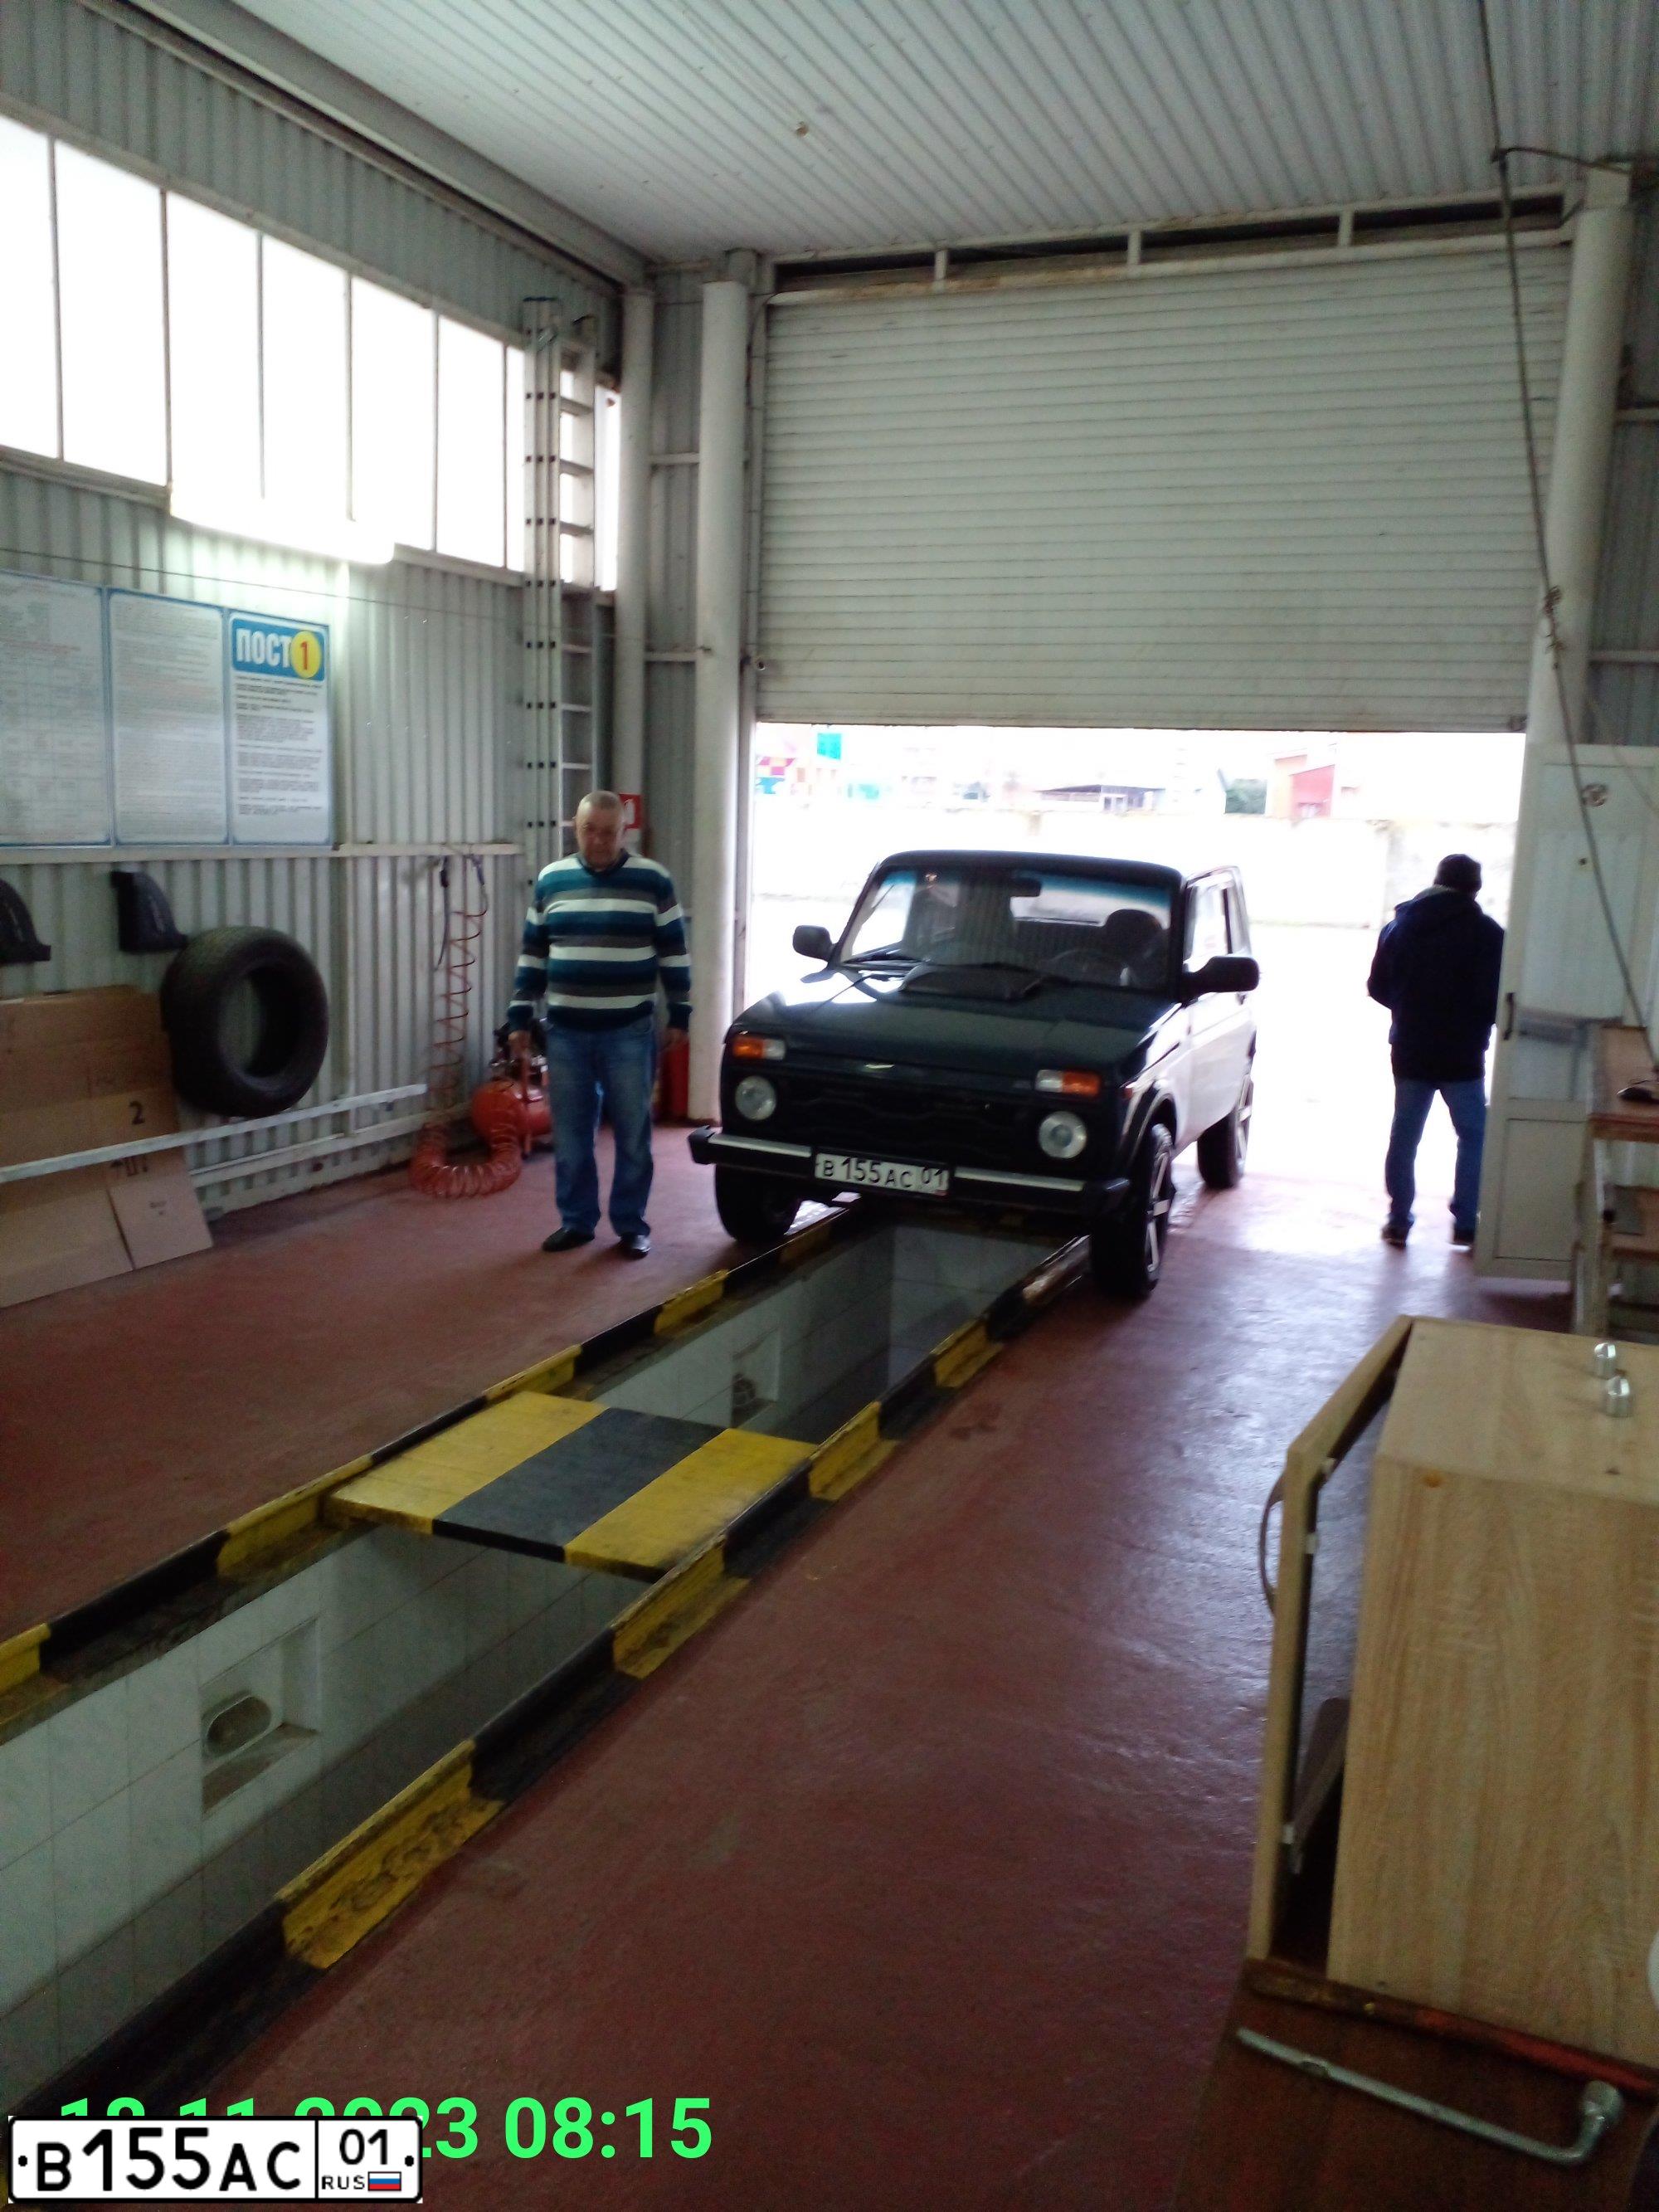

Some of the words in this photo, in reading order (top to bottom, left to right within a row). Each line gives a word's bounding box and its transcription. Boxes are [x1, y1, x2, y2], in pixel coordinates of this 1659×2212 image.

[236, 628, 292, 668] ПОСТ
[300, 641, 308, 670] 1
[129, 1100, 144, 1124] 2
